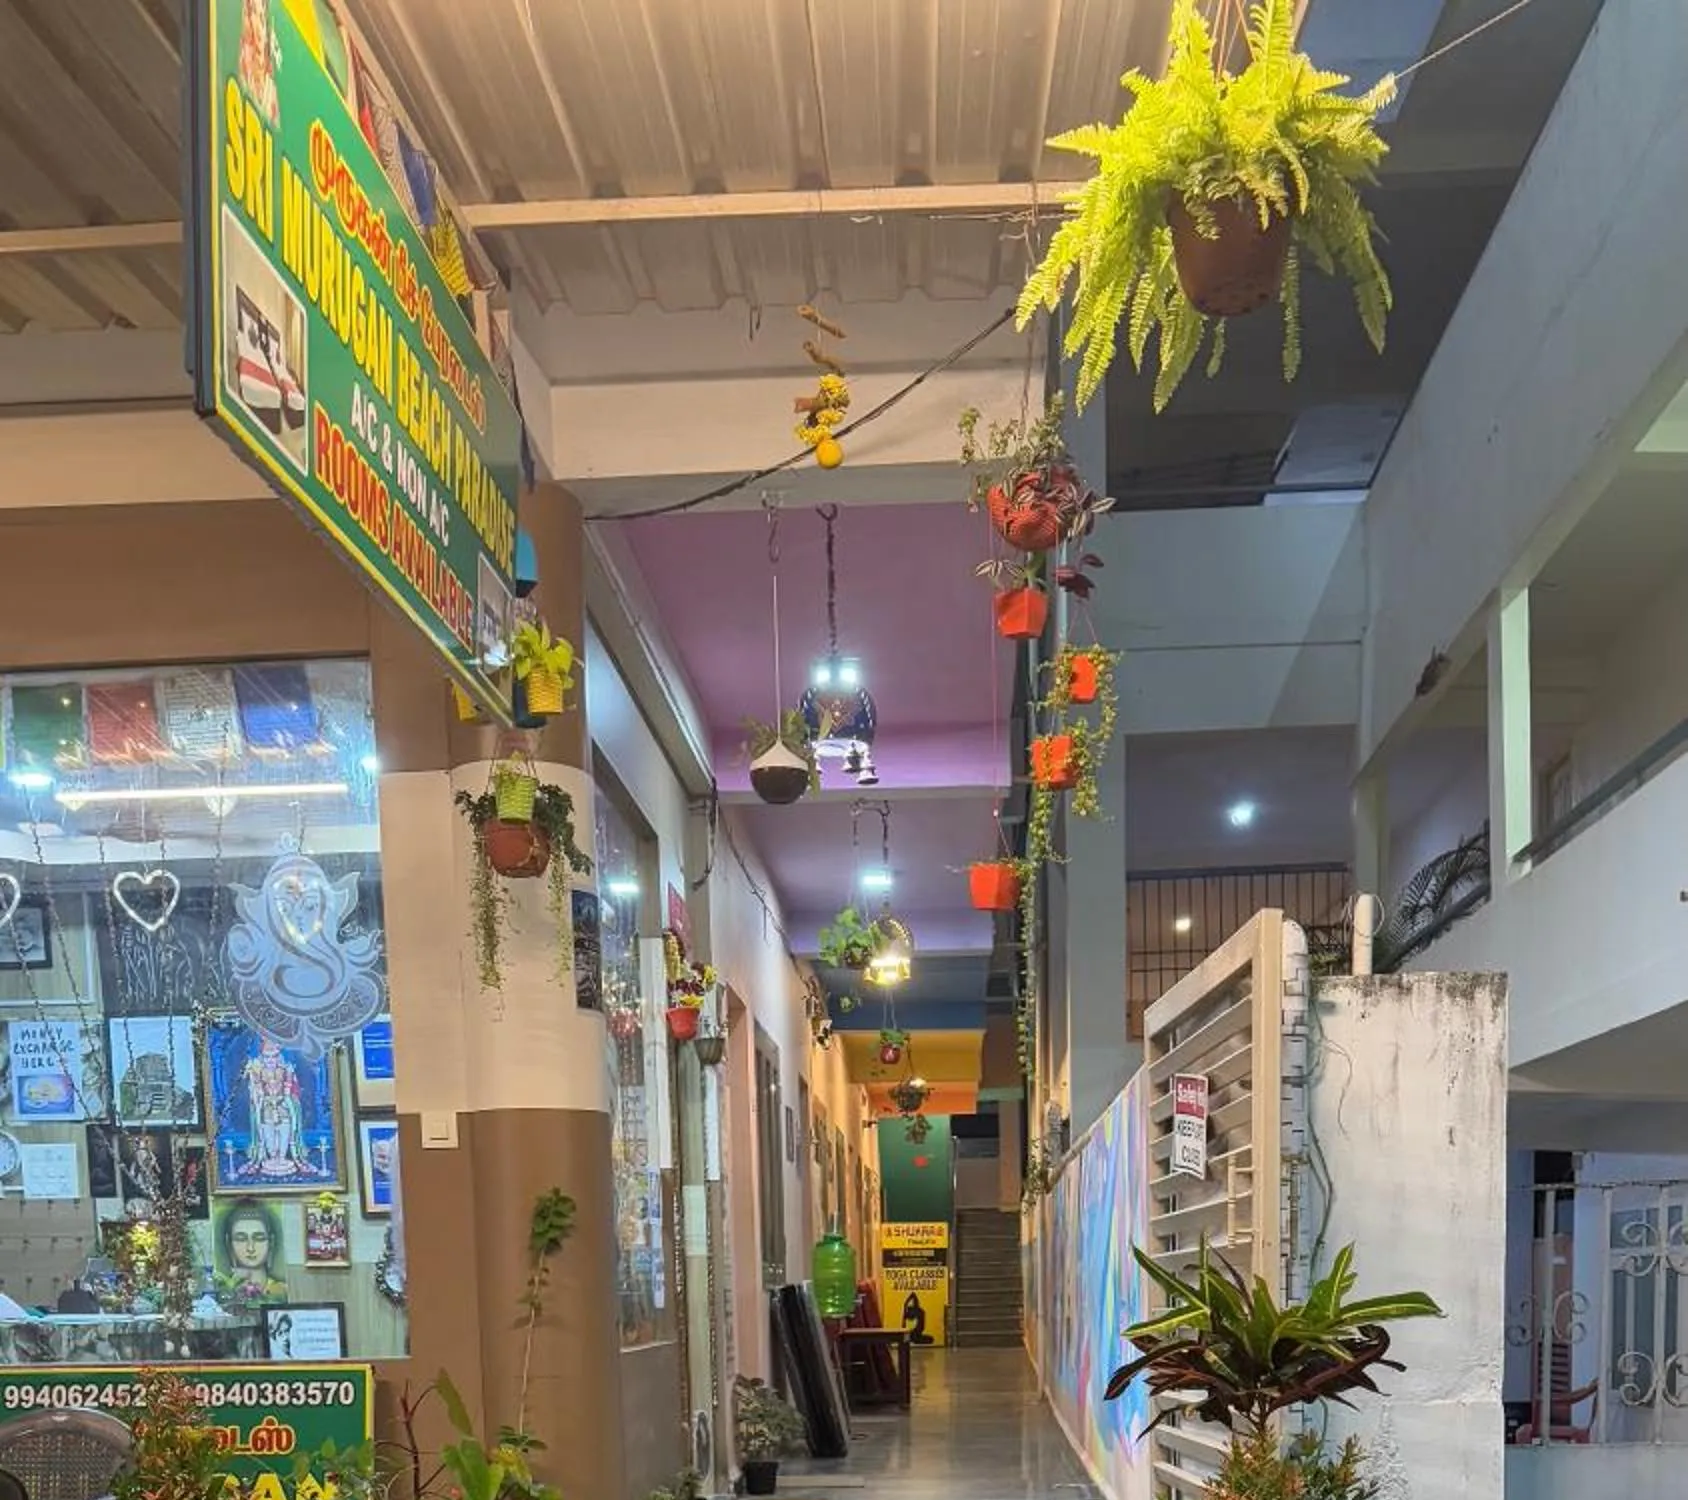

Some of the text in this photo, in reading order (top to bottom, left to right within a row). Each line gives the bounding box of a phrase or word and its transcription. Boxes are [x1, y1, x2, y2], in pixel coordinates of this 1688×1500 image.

[225, 77, 516, 581] SRI MURUGAN BEACH PARADISE
[313, 400, 474, 656] ROOMS AVAILABLE
[382, 423, 393, 474] &
[397, 440, 427, 518] NON
[4, 1382, 356, 1408] 994062452 9840383570
